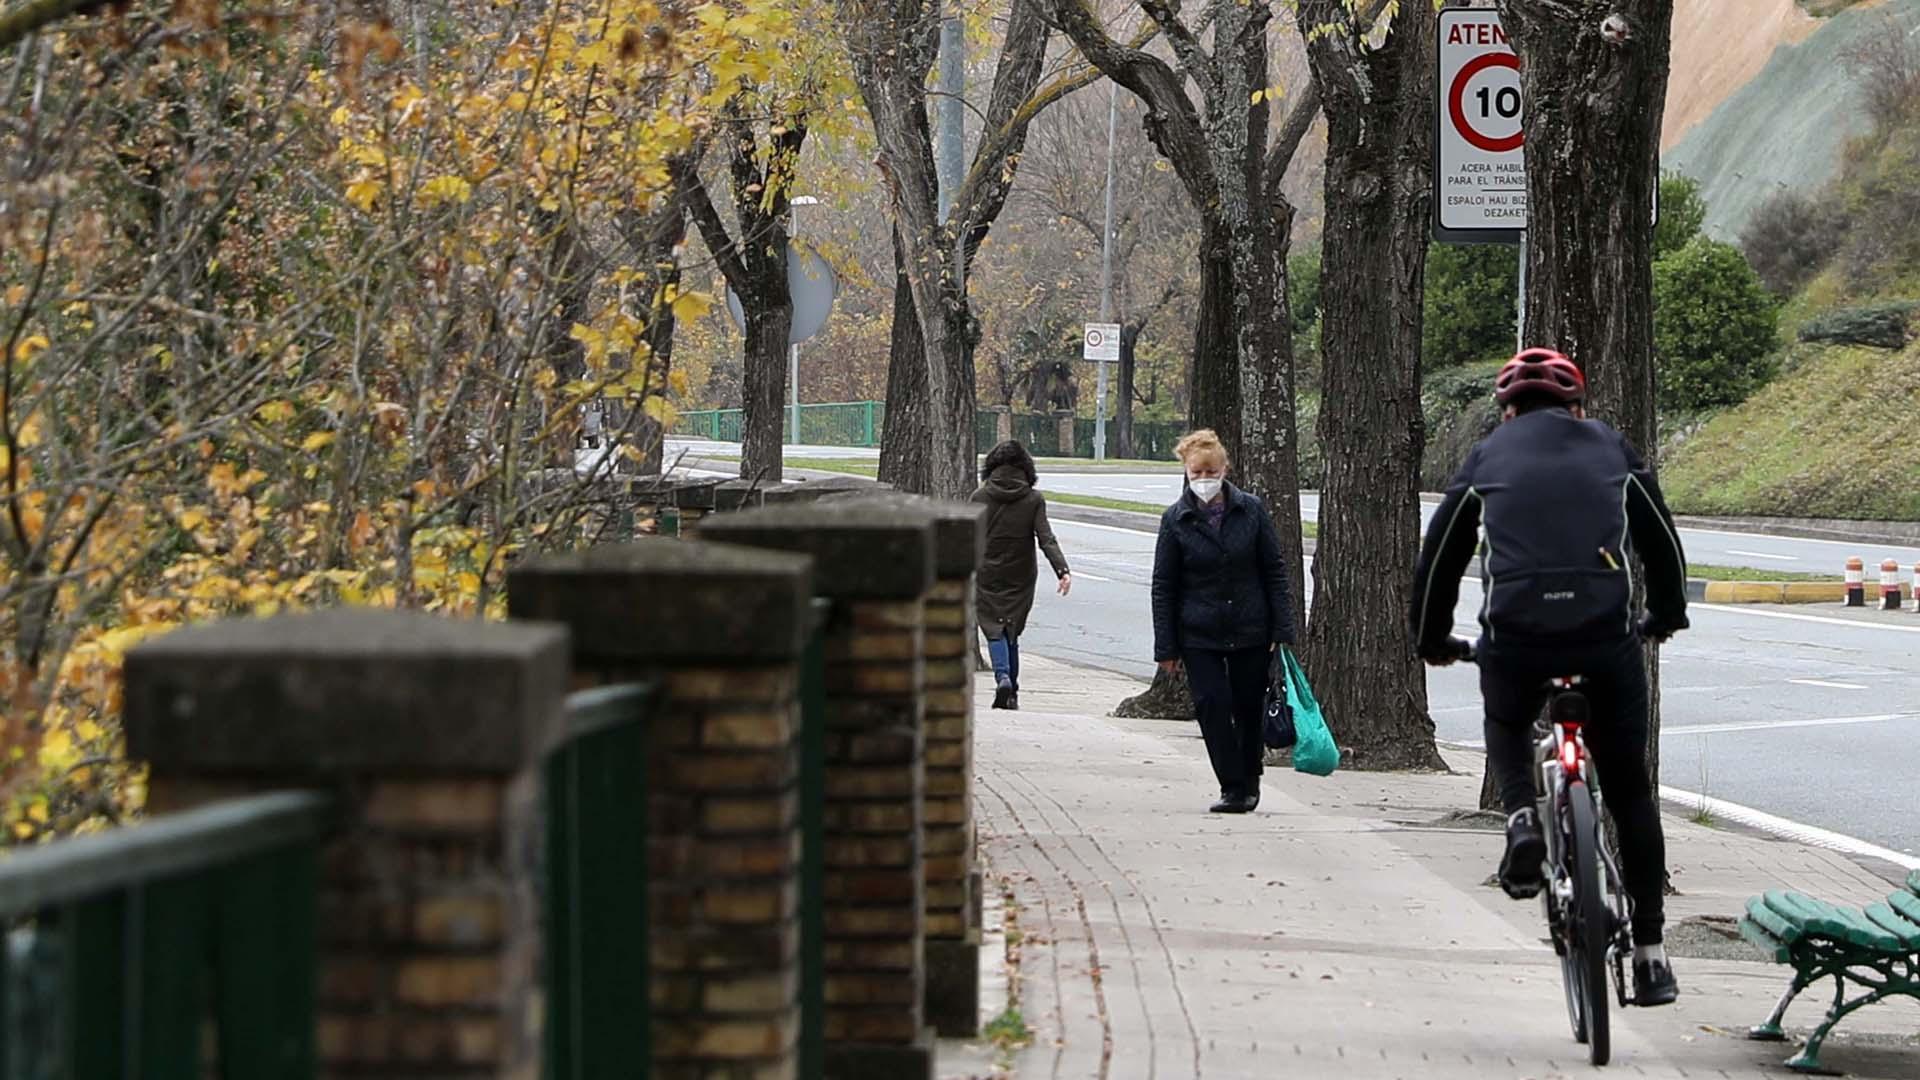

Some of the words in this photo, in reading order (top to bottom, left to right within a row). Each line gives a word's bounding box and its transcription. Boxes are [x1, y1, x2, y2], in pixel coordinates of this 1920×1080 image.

[1476, 87, 1521, 118] 10
[1461, 164, 1492, 172] ACERA
[1448, 176, 1472, 185] PARA
[1477, 176, 1488, 185] EL
[1447, 196, 1485, 205] ESPALOI
[1489, 196, 1507, 205] HAU
